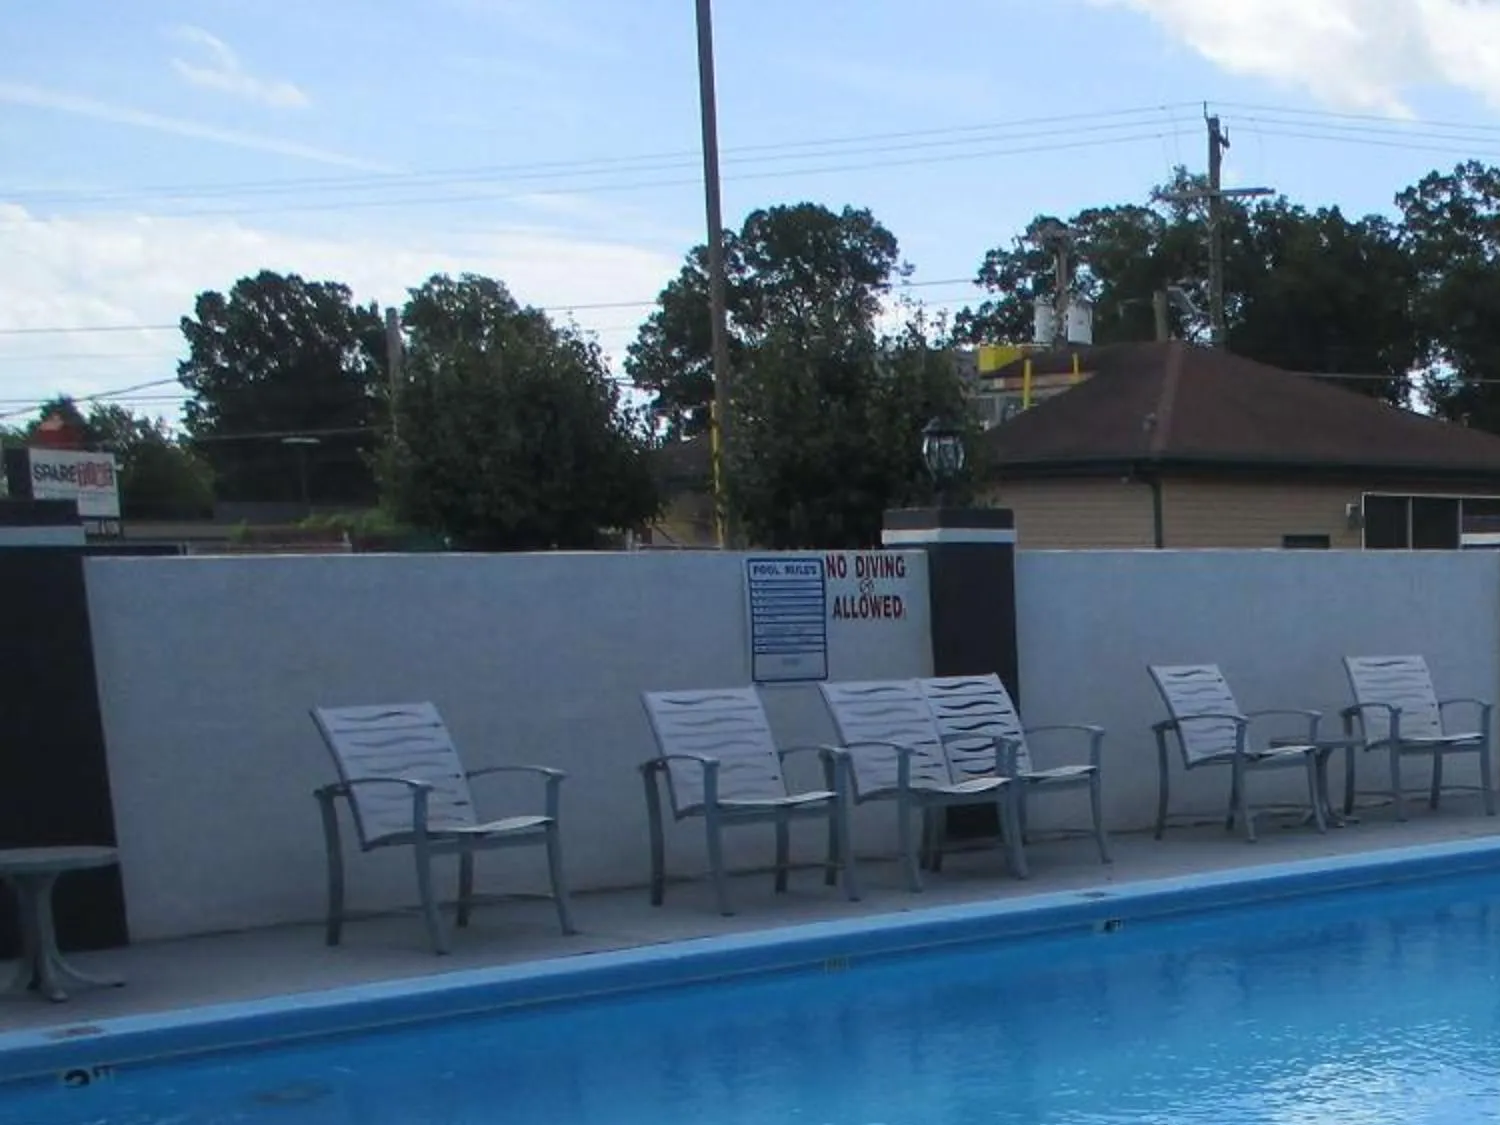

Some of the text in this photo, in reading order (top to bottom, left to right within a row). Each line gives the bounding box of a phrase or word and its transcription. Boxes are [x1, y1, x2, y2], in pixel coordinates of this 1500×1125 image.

[753, 565, 780, 576] POOL
[826, 555, 905, 578] NO DIVING
